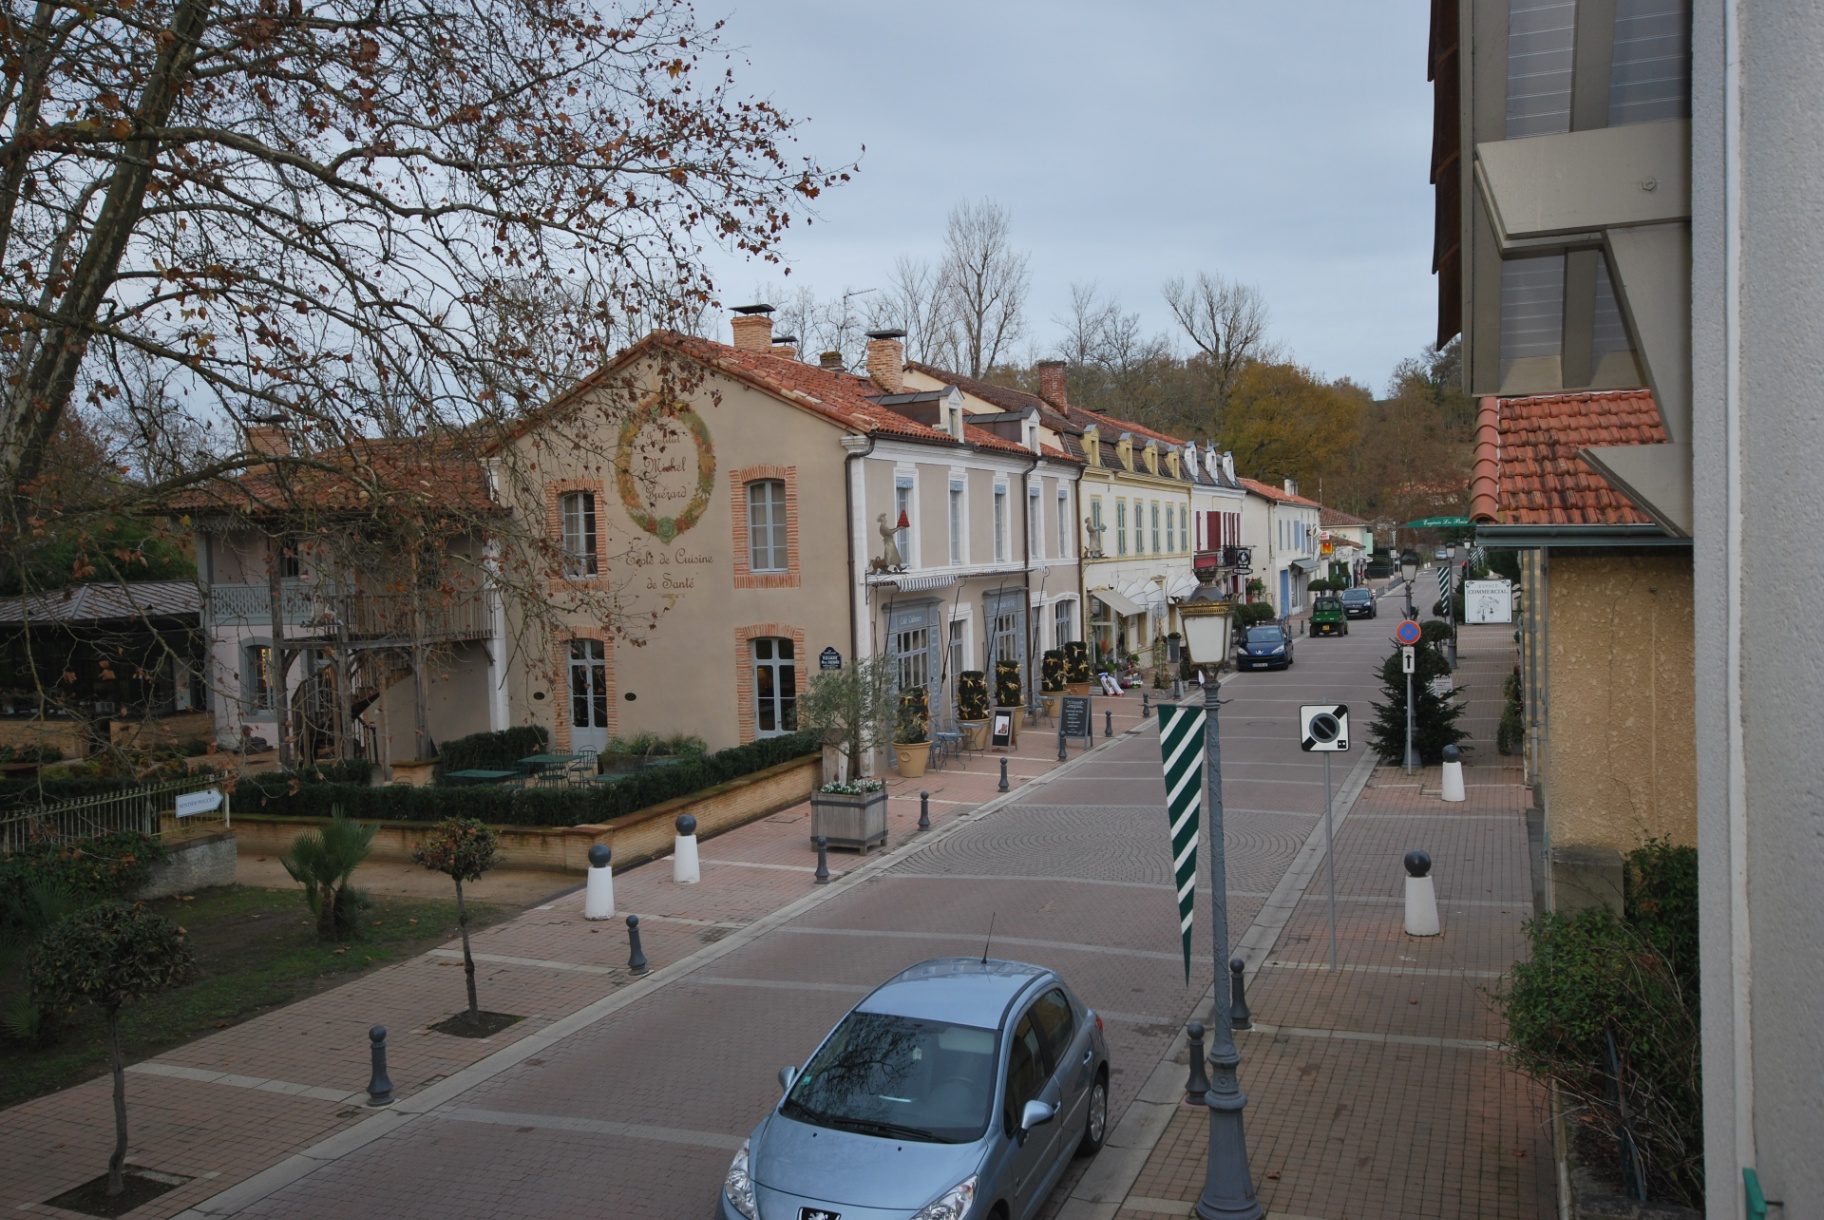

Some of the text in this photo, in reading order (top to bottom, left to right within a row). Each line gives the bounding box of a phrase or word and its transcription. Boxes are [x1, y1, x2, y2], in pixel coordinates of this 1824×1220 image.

[643, 456, 686, 473] Mihel
[645, 483, 687, 501] Guérard
[659, 553, 670, 564] de
[675, 547, 714, 564] Cuisine
[646, 572, 694, 589] de Santé
